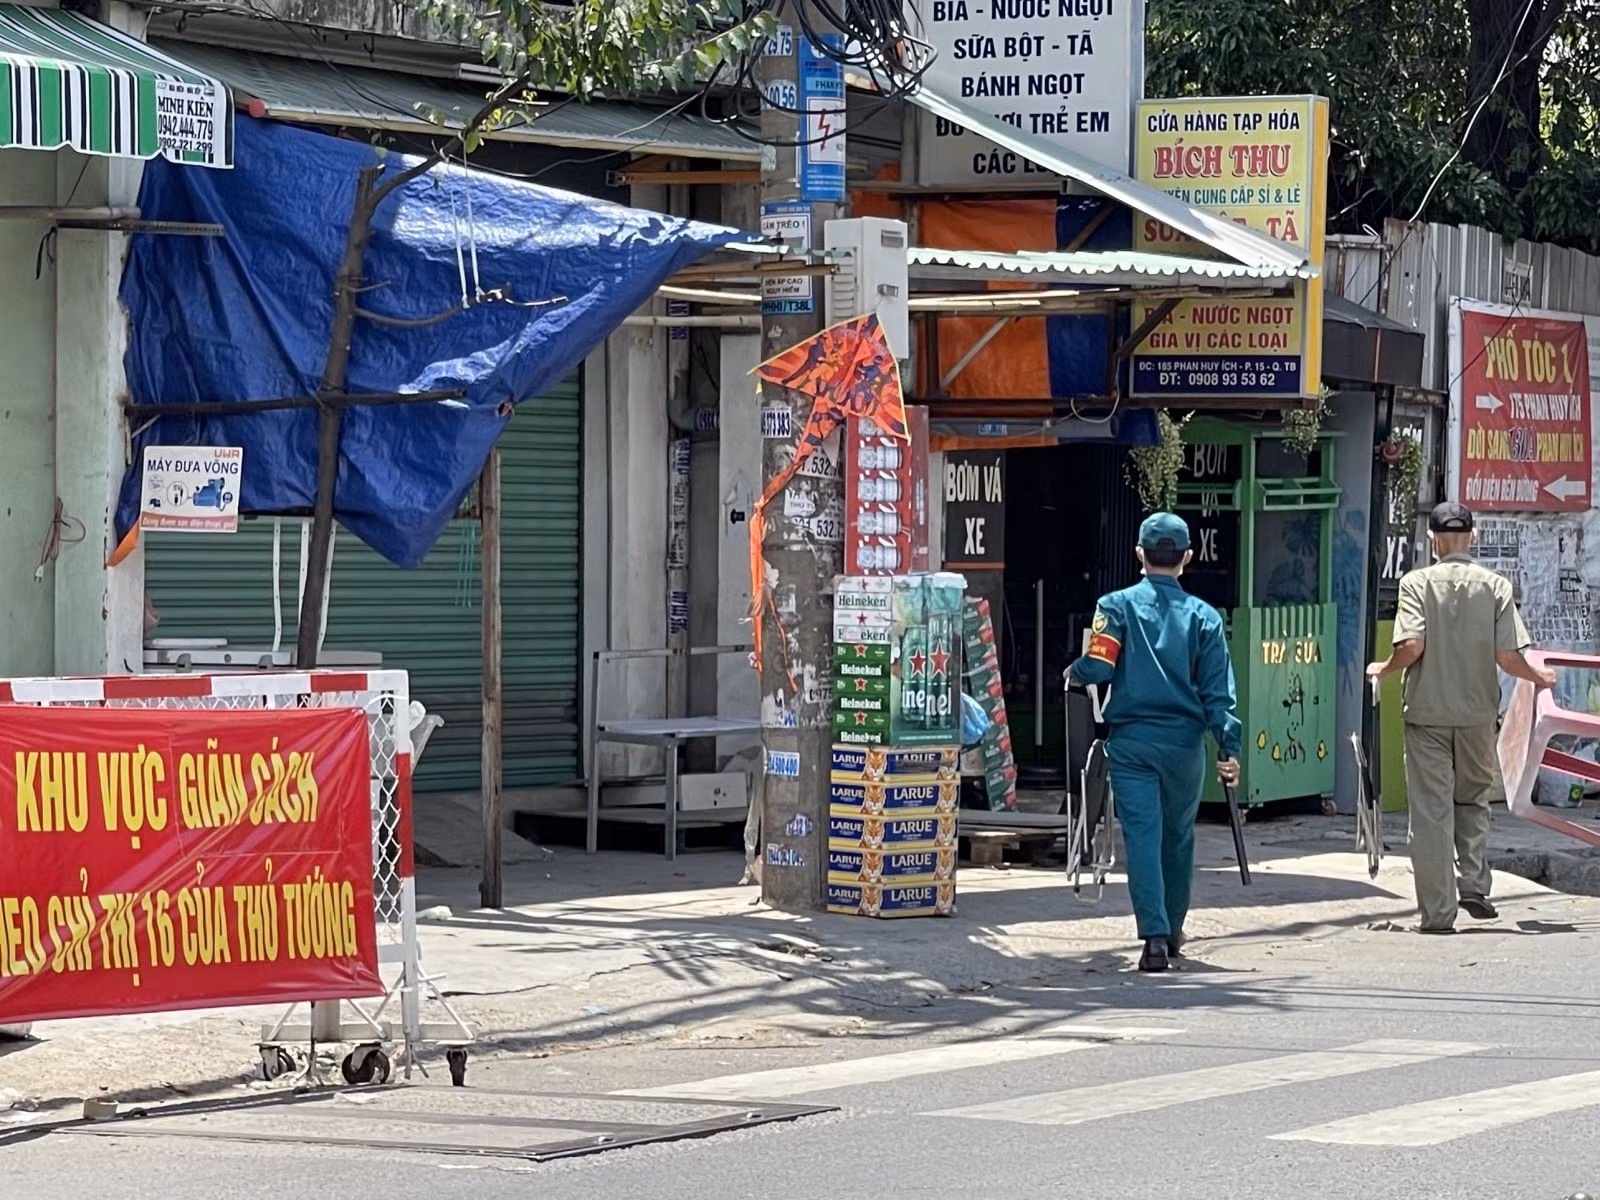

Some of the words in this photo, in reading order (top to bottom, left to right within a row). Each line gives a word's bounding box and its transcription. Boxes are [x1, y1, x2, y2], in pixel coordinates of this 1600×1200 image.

[933, 0, 969, 22] BIA
[953, 33, 997, 59] SỮA
[1004, 32, 1045, 62] BỘT
[1067, 30, 1094, 56] TÃ
[961, 71, 1020, 98] BÁNH
[1028, 73, 1085, 99] NGỌT
[158, 95, 184, 114] MINH
[187, 96, 214, 118] KIÊN
[1029, 105, 1068, 134] TRẺ
[1076, 111, 1109, 133] EM
[1147, 108, 1179, 132] CỬA
[1184, 110, 1227, 132] HÀNG
[1233, 113, 1263, 134] TẠP
[1268, 108, 1300, 130] HÓA
[973, 148, 1016, 174] CÁC
[1154, 137, 1223, 178] BÍCH
[1229, 144, 1291, 178] THU
[1194, 188, 1226, 204] CUNG
[1231, 183, 1254, 204] CẤP
[1274, 189, 1283, 202] &
[1287, 183, 1300, 203] LẺ
[1266, 210, 1299, 241] TÃ
[1144, 307, 1174, 324] BA
[1192, 303, 1240, 324] NƯỚC
[1247, 307, 1294, 328] NGỌT
[1149, 332, 1178, 348] GIA
[1185, 332, 1201, 352] VỊ
[1207, 330, 1242, 348] CÁC
[1248, 332, 1288, 352] LOẠI
[1157, 362, 1172, 371] 185
[1174, 362, 1199, 371] PHAN
[1200, 362, 1219, 370] HUY
[1221, 358, 1238, 371] ÍCH
[1255, 362, 1264, 370] 15
[1284, 362, 1297, 371] TB
[1484, 323, 1519, 382] PHỐ
[1522, 331, 1556, 384] TÓC
[1159, 373, 1181, 386] ĐT:
[1188, 373, 1219, 386] 0908
[1222, 373, 1237, 386] 93
[1241, 373, 1256, 386] 53
[1260, 373, 1275, 386] 62
[147, 456, 173, 472] MÁY
[175, 460, 201, 473] ĐƯA
[204, 459, 238, 474] VÕNG
[946, 459, 979, 502] BƠM
[983, 457, 1002, 502] VÁ
[964, 517, 985, 555] XE
[1199, 528, 1219, 562] XE
[1382, 536, 1408, 579] XE
[838, 595, 887, 608] Heineken
[841, 664, 882, 676] Heineken
[840, 697, 882, 709] Heineken
[833, 753, 865, 764] LARUE
[15, 751, 89, 833] KHU
[97, 743, 168, 849] VỰC
[178, 737, 248, 830] GIÃN
[249, 736, 319, 826] CÁCH
[832, 787, 864, 798] LARUE
[894, 787, 934, 800] LARUE
[831, 821, 864, 832] LARUE
[893, 821, 933, 834] LARUE
[830, 854, 862, 865] LARUE
[892, 853, 932, 868] LARUE
[829, 888, 860, 899] LARUE
[891, 887, 932, 902] LARUE
[47, 867, 96, 973] CHỈ
[98, 892, 141, 987] THỊ
[141, 889, 176, 967] 16
[177, 861, 231, 966] CỦA
[233, 858, 279, 962] THỦ
[282, 866, 357, 960] TƯỚNG
